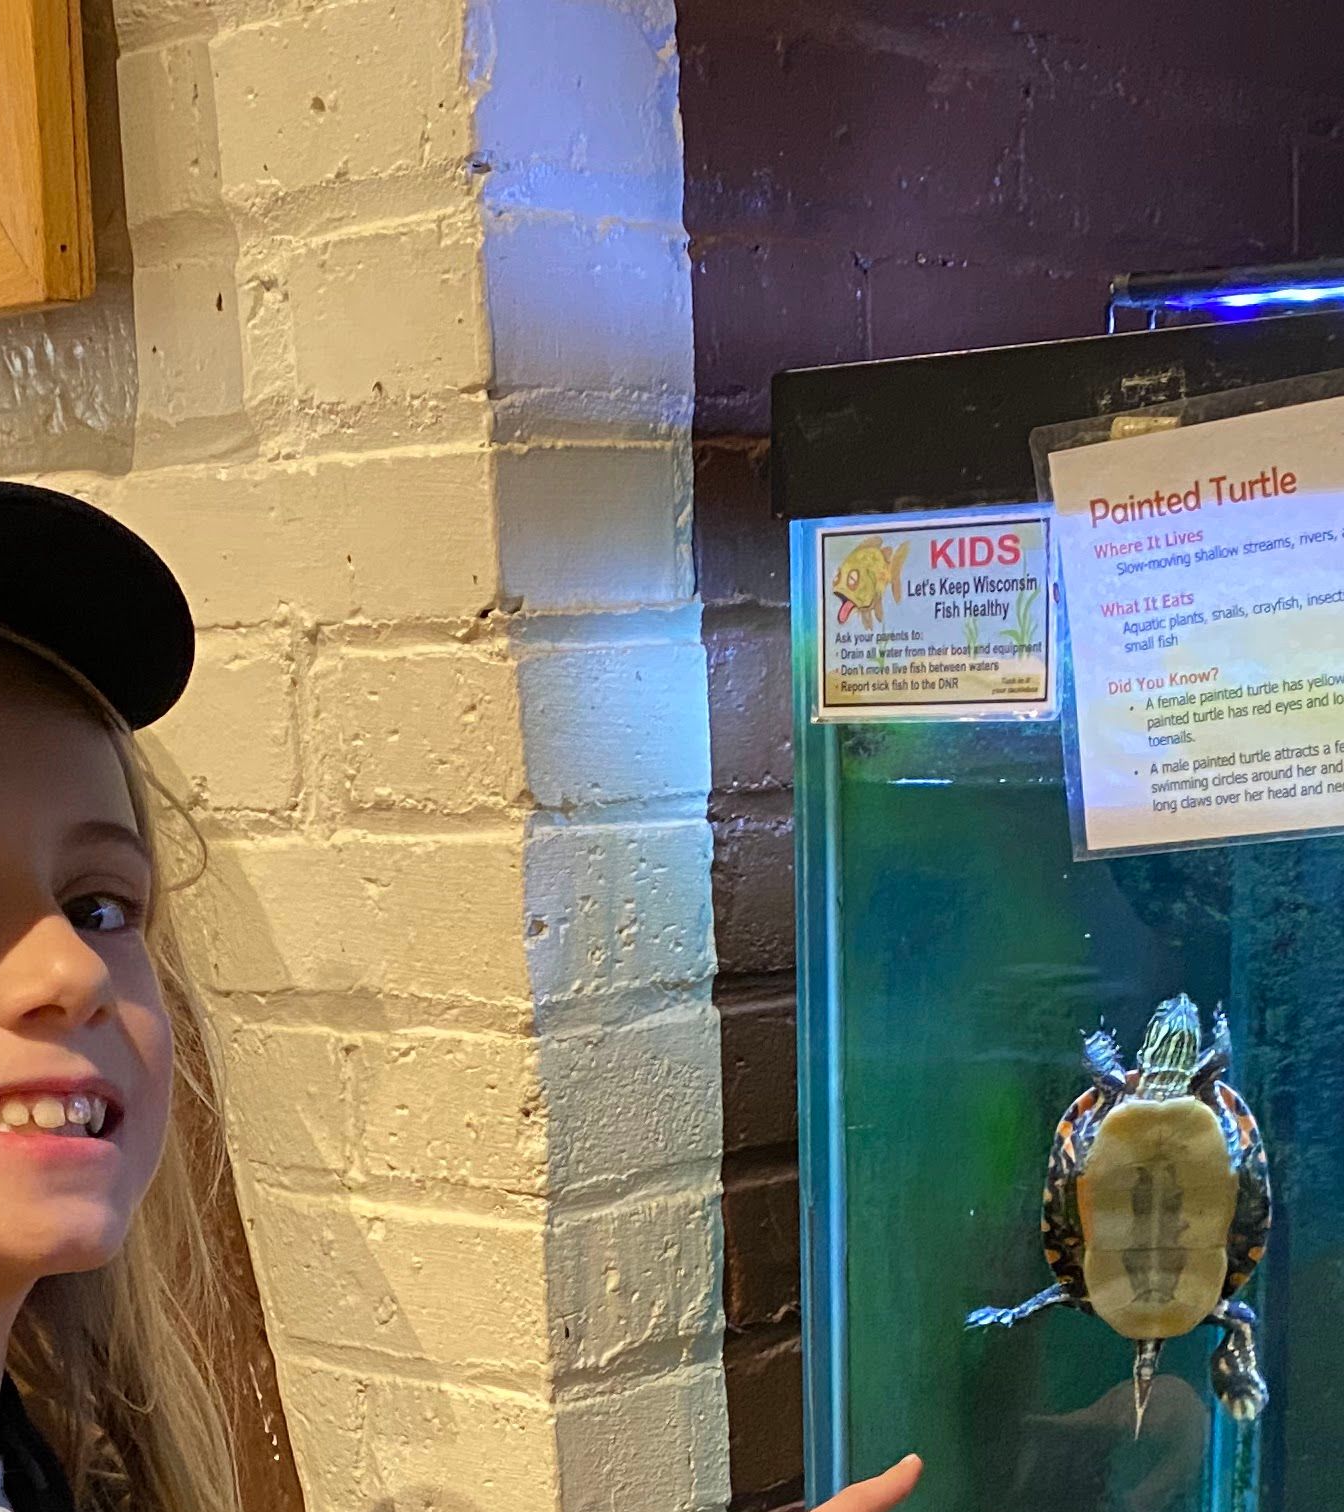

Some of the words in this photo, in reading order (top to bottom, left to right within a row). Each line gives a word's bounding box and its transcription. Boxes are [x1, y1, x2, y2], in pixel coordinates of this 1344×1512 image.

[1089, 480, 1201, 528] Painted
[1209, 466, 1297, 506] Turtle
[930, 533, 1021, 569] KIDS
[1094, 538, 1143, 559] Where
[1147, 536, 1160, 551] It
[1165, 528, 1203, 547] Lives
[1117, 552, 1191, 576] Slow-moving
[1195, 544, 1239, 562] shallow
[1244, 535, 1294, 554] streams,
[1300, 528, 1338, 546] rivers,
[908, 579, 936, 597] Let's
[939, 578, 969, 598] Keep
[974, 574, 1037, 593] Wisconsin
[935, 602, 960, 619] Fish
[964, 601, 1009, 620] Healthy
[1101, 600, 1141, 617] What
[1145, 598, 1157, 612] It
[1163, 592, 1194, 608] Eats
[1123, 616, 1165, 636] Aquatic
[1169, 610, 1206, 630] plants,
[1212, 603, 1248, 620] snails,
[1253, 596, 1302, 616] crayfish,
[835, 632, 851, 644] Ask
[855, 632, 874, 644] your
[876, 630, 908, 644] parents
[912, 630, 924, 640] to:
[841, 647, 864, 660] Drain
[866, 647, 877, 659] all
[880, 646, 902, 658] water
[905, 646, 926, 657] from
[928, 644, 948, 656] their
[951, 643, 971, 654] boat
[993, 641, 1042, 656] equipment
[1124, 637, 1154, 653] small
[1158, 635, 1178, 648] fish
[841, 664, 864, 676] Don't
[892, 663, 907, 674] live
[910, 662, 926, 673] fish
[929, 661, 966, 673] between
[969, 661, 999, 672] waters
[1108, 680, 1132, 695] Did
[1137, 677, 1164, 692] You
[1170, 667, 1219, 687] Know?
[841, 681, 869, 694] Report
[872, 680, 889, 691] sick
[892, 679, 908, 690] fish
[911, 679, 919, 690] to
[922, 679, 936, 689] the
[939, 677, 958, 690] DNR
[1146, 697, 1154, 711] A
[1157, 691, 1196, 709] female
[1200, 686, 1242, 706] painted
[1247, 682, 1279, 697] turtle
[1282, 679, 1303, 692] has
[1307, 673, 1344, 692] yellow
[1147, 712, 1189, 731] painted
[1193, 707, 1224, 724] turtle
[1227, 704, 1248, 719] has
[1252, 701, 1272, 715] red
[1276, 699, 1302, 715] eyes
[1306, 694, 1329, 709] and
[1148, 729, 1196, 747] toenails.
[1151, 761, 1159, 775] A
[1162, 756, 1189, 773] male
[1193, 751, 1236, 772] painted
[1240, 747, 1270, 764] turtle
[1274, 742, 1319, 760] attracts
[1324, 745, 1331, 755] a
[1152, 775, 1208, 793] swimming
[1212, 769, 1248, 788] circles
[1251, 767, 1292, 783] around
[1296, 763, 1316, 778] her
[1321, 759, 1342, 774] and
[1152, 797, 1178, 814] long
[1180, 793, 1211, 810] claws
[1215, 791, 1240, 805] over
[1245, 787, 1264, 803] her
[1267, 783, 1297, 800] head
[1301, 780, 1323, 795] and
